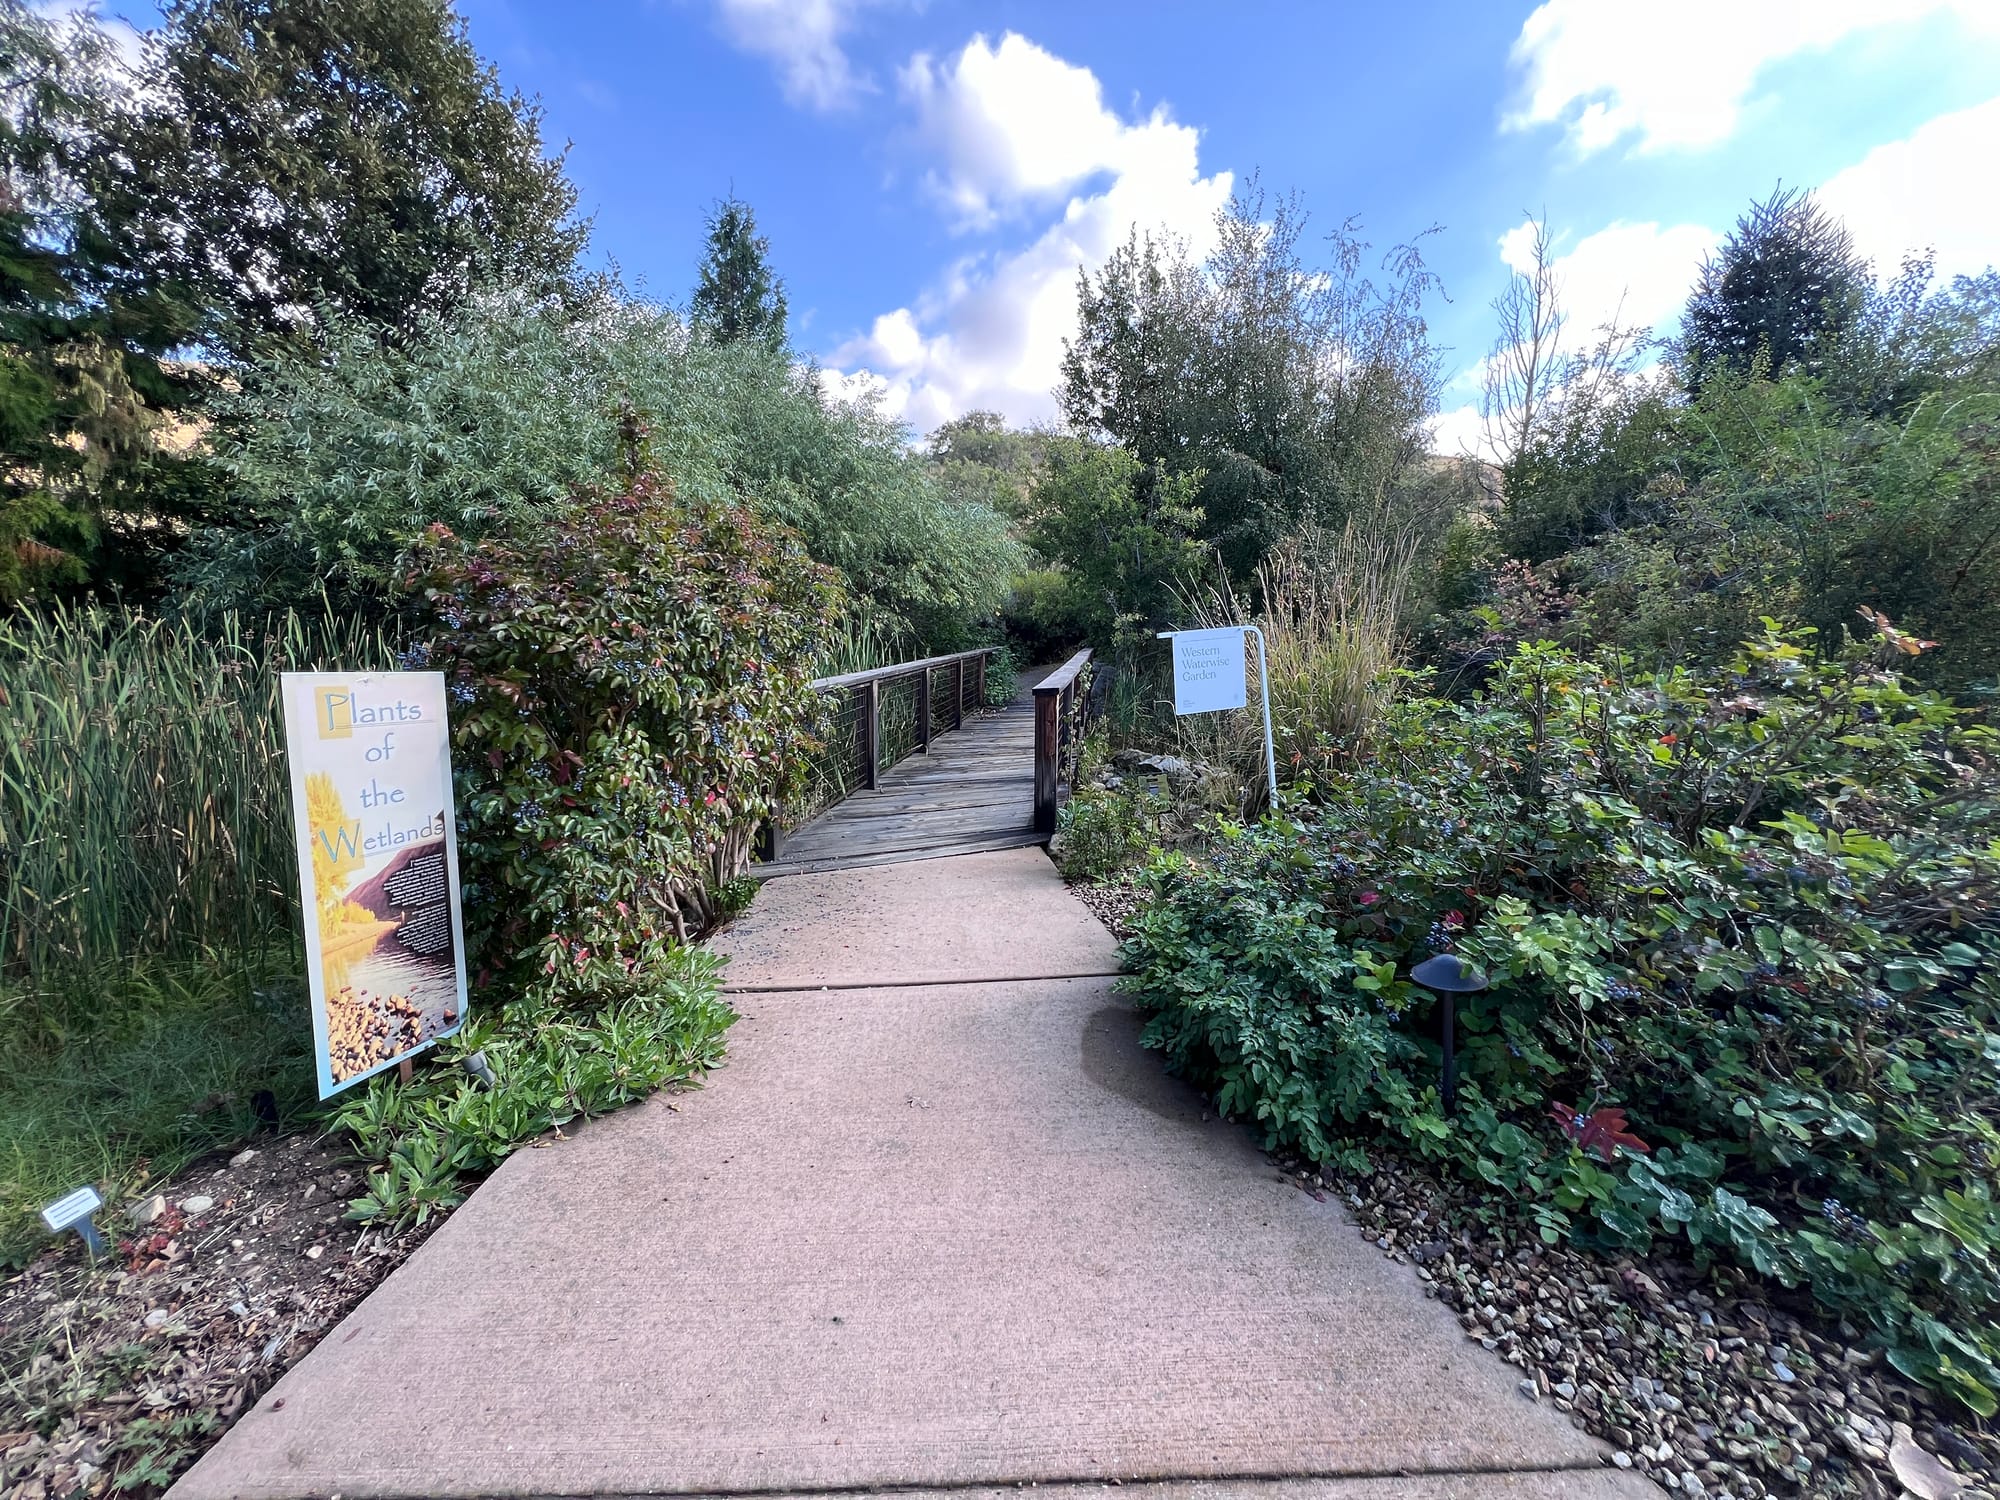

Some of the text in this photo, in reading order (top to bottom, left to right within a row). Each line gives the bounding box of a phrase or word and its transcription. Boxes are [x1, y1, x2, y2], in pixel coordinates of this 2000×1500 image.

[1181, 647, 1220, 657] Western
[1182, 657, 1230, 669] Waterwise
[1182, 669, 1217, 681] Garden
[325, 692, 422, 731] Plants
[365, 732, 394, 762] of
[360, 778, 405, 808] the
[319, 815, 445, 863] Wetlands
